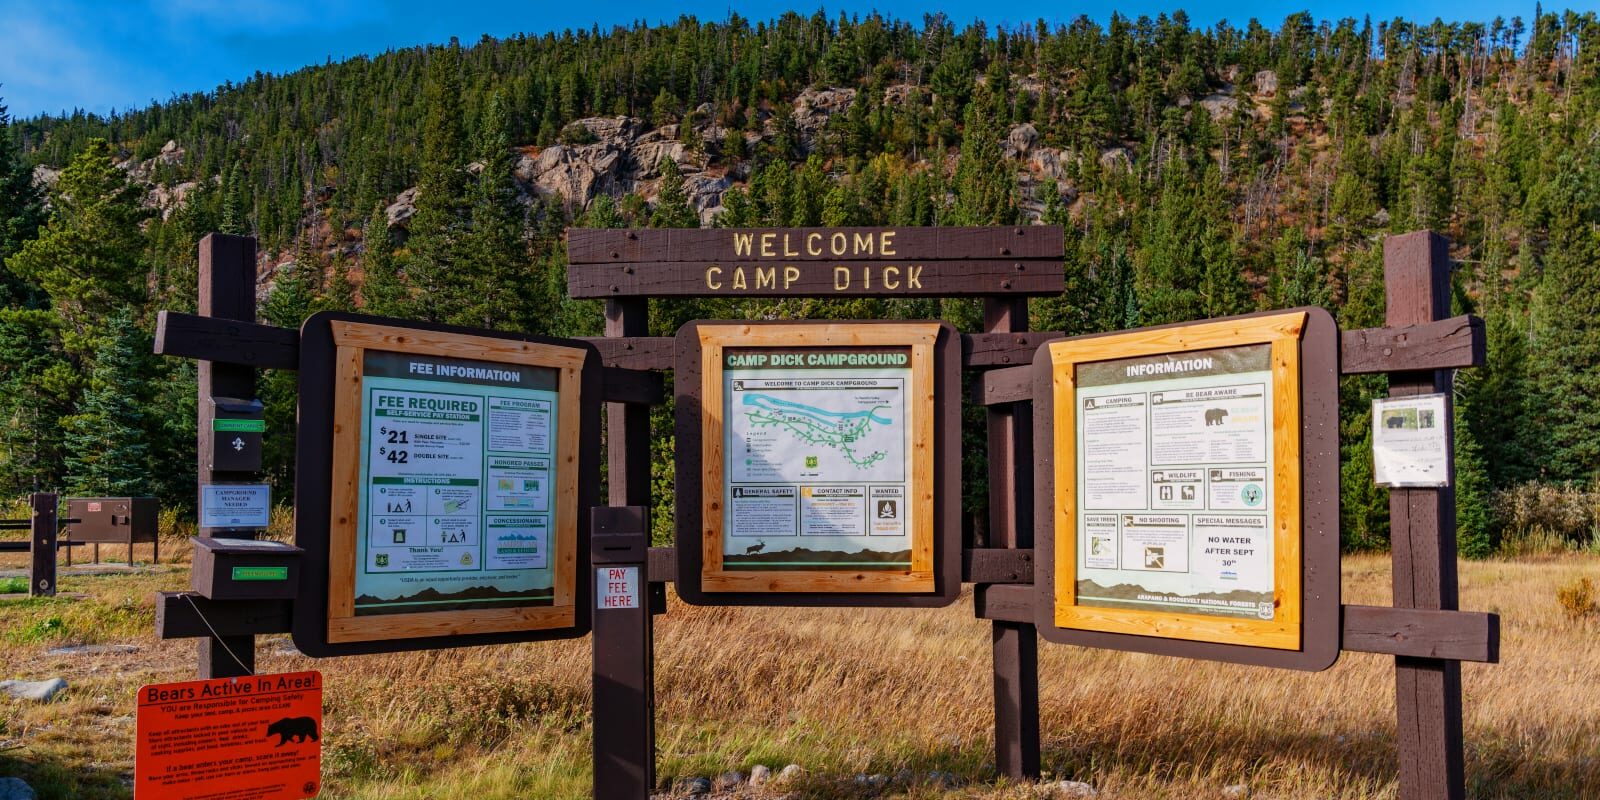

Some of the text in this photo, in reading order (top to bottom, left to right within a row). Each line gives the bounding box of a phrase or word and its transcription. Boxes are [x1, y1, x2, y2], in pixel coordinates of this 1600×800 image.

[733, 232, 896, 256] WELCOME
[706, 266, 923, 290] CAMP DICK
[728, 353, 907, 366] CAMP DICK CAMPGROUND
[409, 362, 520, 382] FEE INFORMATION
[1126, 358, 1213, 377] INFORMATION
[379, 396, 478, 412] FEE REQUIRED
[387, 409, 431, 417] SELF-SERVICE
[609, 569, 626, 580] PAY
[608, 582, 627, 593] FEE
[604, 596, 632, 607] HERE
[1169, 596, 1200, 604] ROOSEVELT
[147, 675, 316, 702] Bears Active In Area!
[193, 700, 236, 711] Responsible
[250, 696, 280, 705] Camping
